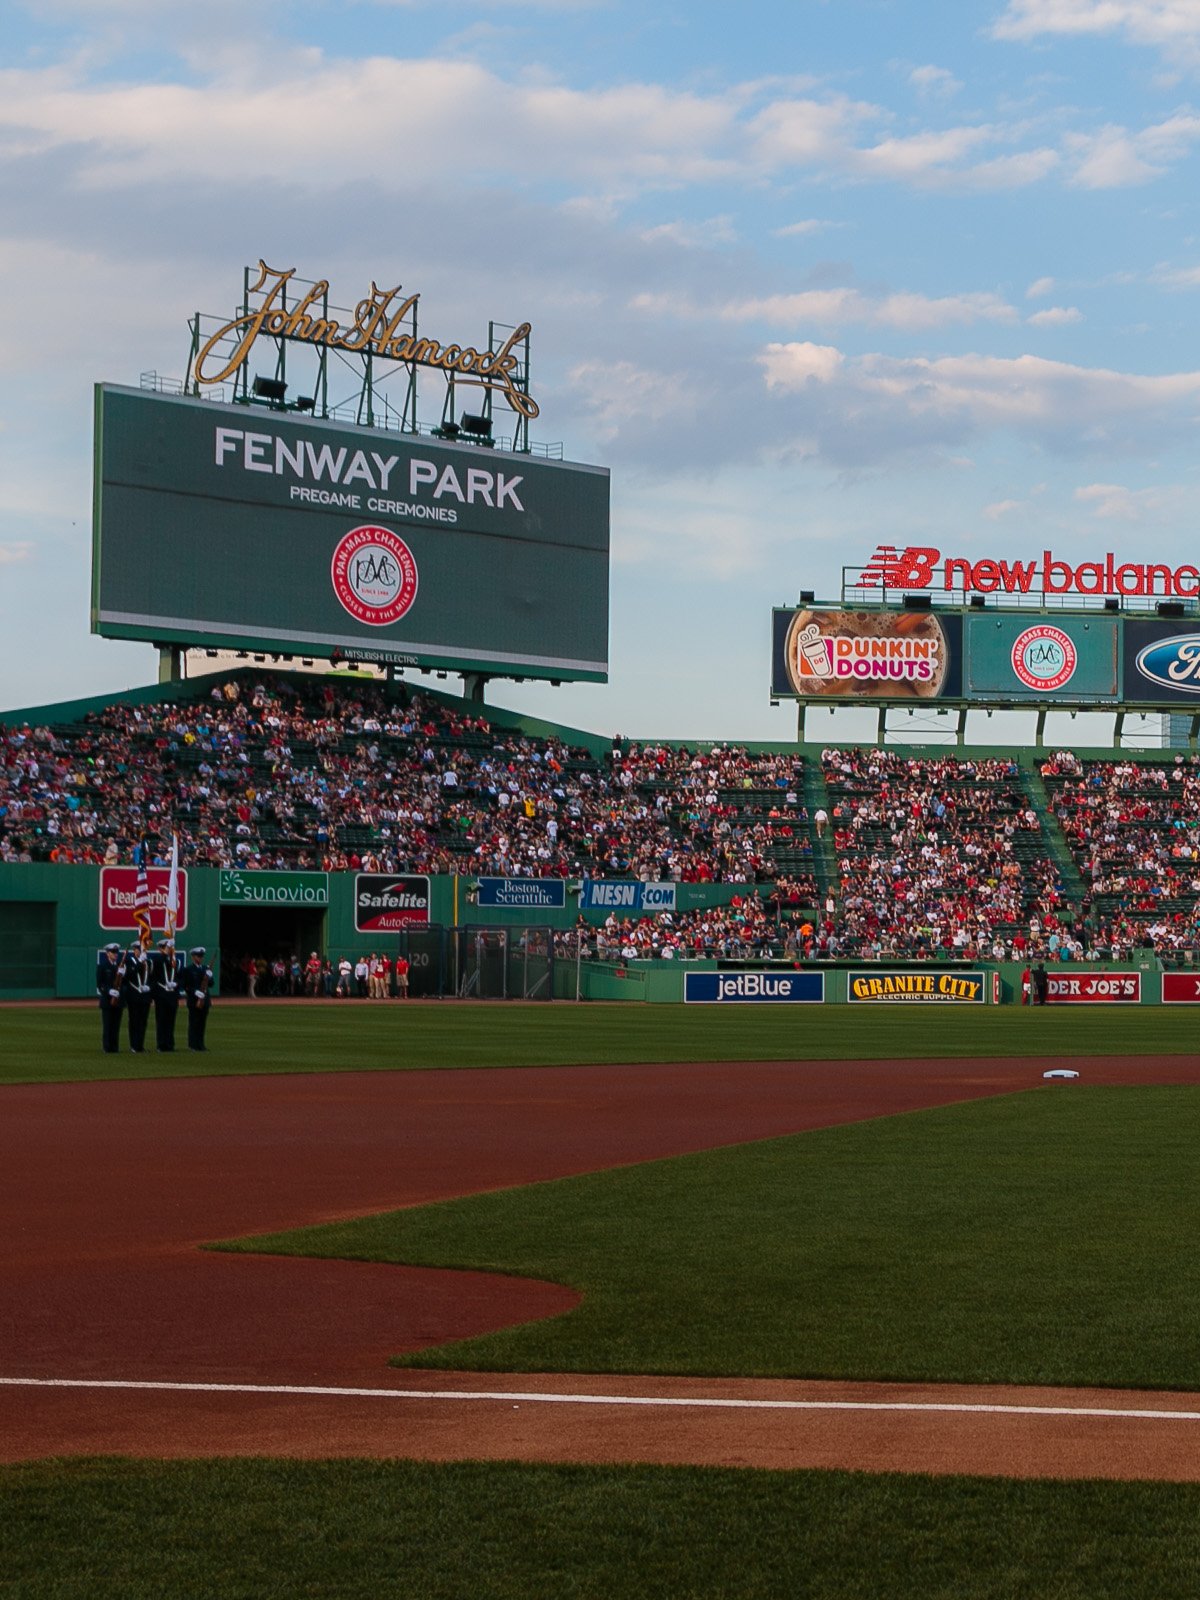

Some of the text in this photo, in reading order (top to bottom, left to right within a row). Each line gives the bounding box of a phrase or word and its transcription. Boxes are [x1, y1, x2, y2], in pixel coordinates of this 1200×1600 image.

[194, 259, 540, 418] John Hancock
[215, 427, 524, 512] FENWAY PARK
[290, 486, 457, 523] PREGAME CEREMONIES
[336, 531, 414, 584] PAN-MASS CHALLENGE
[944, 558, 1036, 593] new
[340, 585, 364, 615] CLOSER
[365, 611, 376, 619] BY
[380, 609, 394, 619] THE
[837, 639, 935, 658] DUNKIN'
[1042, 629, 1074, 662] CHALLENGE
[344, 650, 419, 665] MITSUBISHI ELECTRIC
[837, 659, 931, 678] DONUTS
[243, 883, 326, 901] sunovion
[496, 886, 553, 904] Scientific
[503, 880, 540, 894] Boston
[591, 884, 635, 906] NESN
[358, 893, 427, 908] Safelite
[717, 975, 792, 1000] jetBlue
[853, 976, 935, 998] GRANITE
[938, 975, 981, 998] CITY
[1085, 979, 1137, 996] JOE'S
